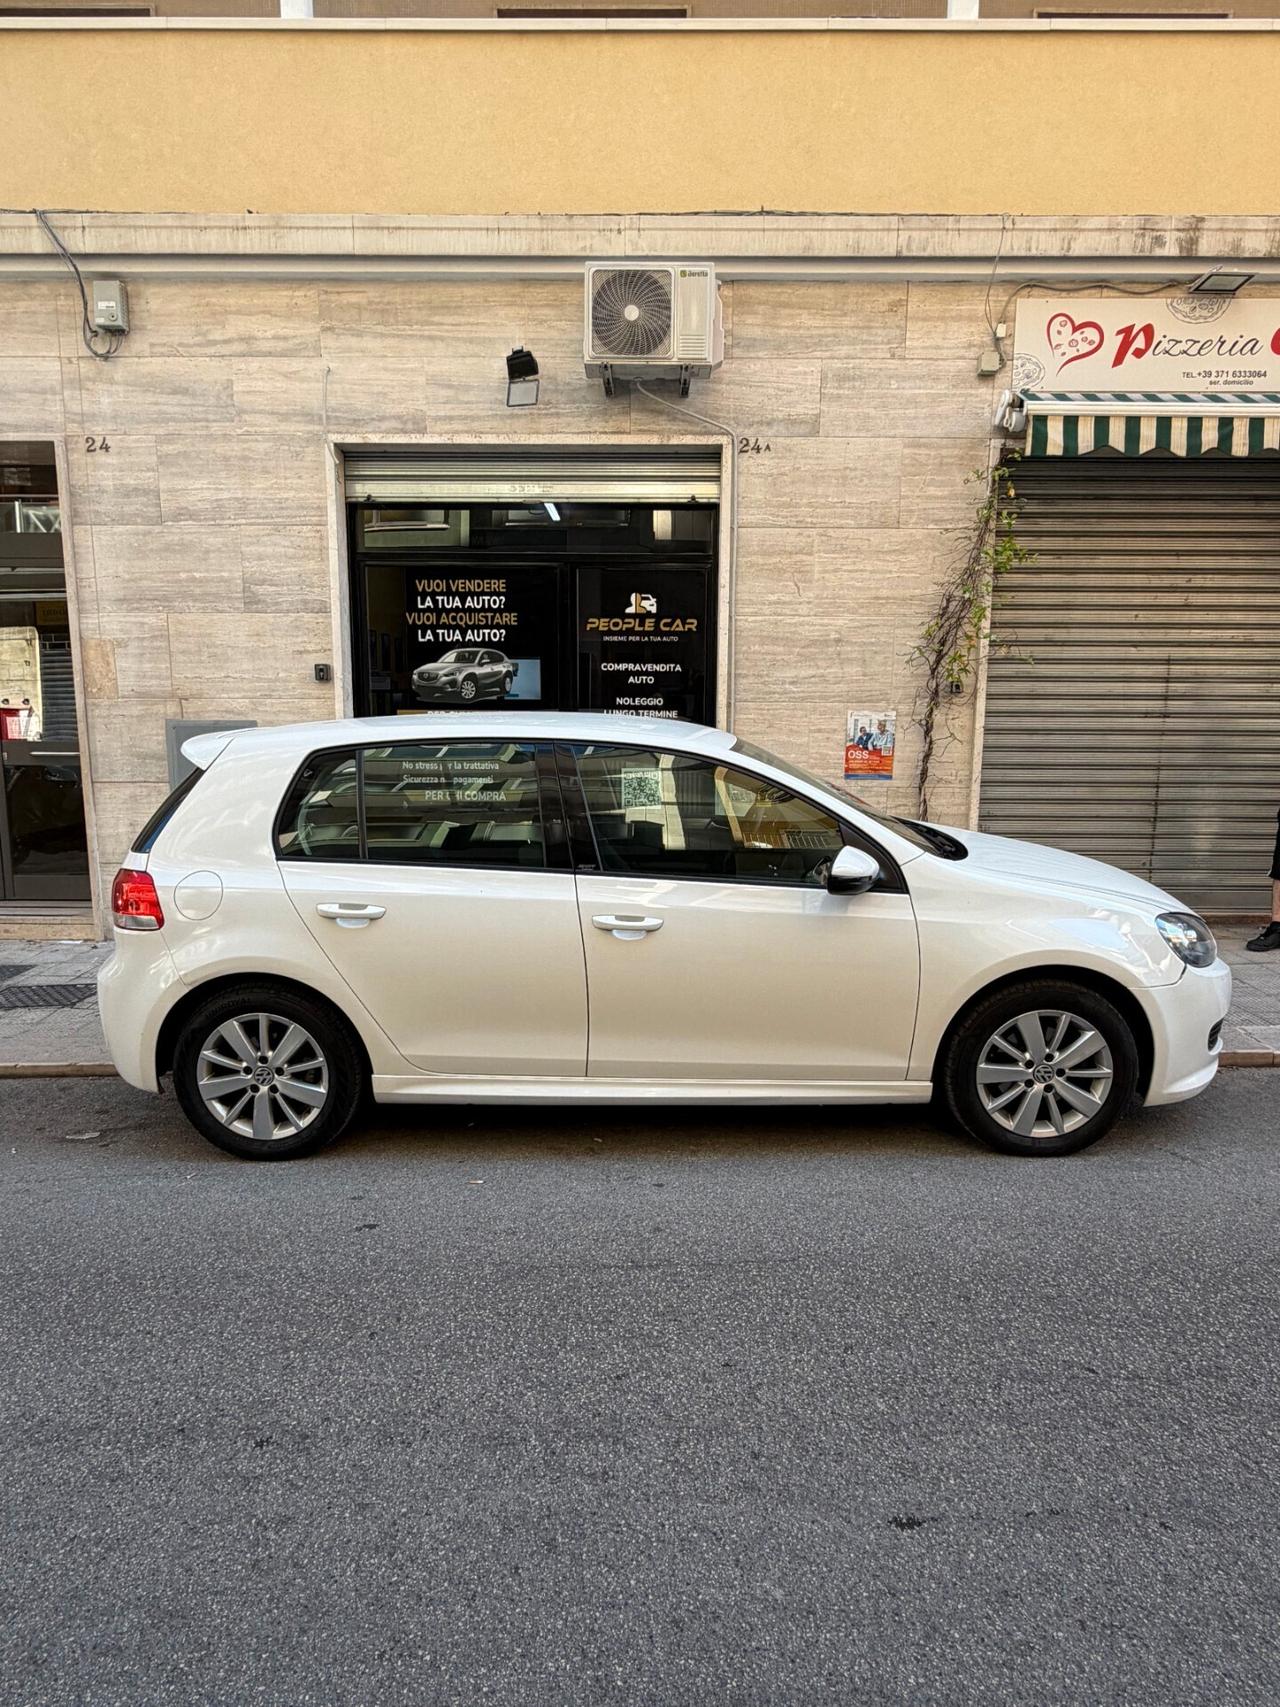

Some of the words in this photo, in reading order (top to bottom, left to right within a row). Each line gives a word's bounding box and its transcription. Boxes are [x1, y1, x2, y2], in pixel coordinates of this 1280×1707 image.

[1112, 323, 1264, 368] Pizzeria
[1214, 370, 1229, 378] 371
[1232, 370, 1267, 378] 6333064
[85, 436, 111, 453] 24
[415, 579, 447, 592] VUOI
[449, 579, 507, 592] VENDERE
[417, 595, 434, 609] LA
[436, 595, 462, 609] TUA
[465, 595, 506, 609] AUTO?
[405, 612, 437, 625] VUOI
[440, 612, 518, 628] ACQUISTARE
[586, 618, 656, 631] PEOPLE
[659, 618, 698, 631] CAR
[418, 629, 434, 642] LA
[436, 629, 462, 642] TUA
[465, 629, 506, 642] AUTO?
[601, 663, 682, 672] COMPRAVENDITA
[628, 676, 655, 684] AUTO
[616, 697, 664, 706] NOLEGGIO
[638, 709, 679, 719] TERMINE
[847, 750, 869, 759] OSS
[402, 761, 413, 770] No
[415, 762, 438, 770] stress
[454, 761, 462, 770] la
[463, 761, 499, 770] trattativa
[402, 774, 438, 783] Sicurezza
[453, 775, 494, 785] pagamenti
[425, 791, 444, 801] PER
[465, 791, 507, 801] COMPRA
